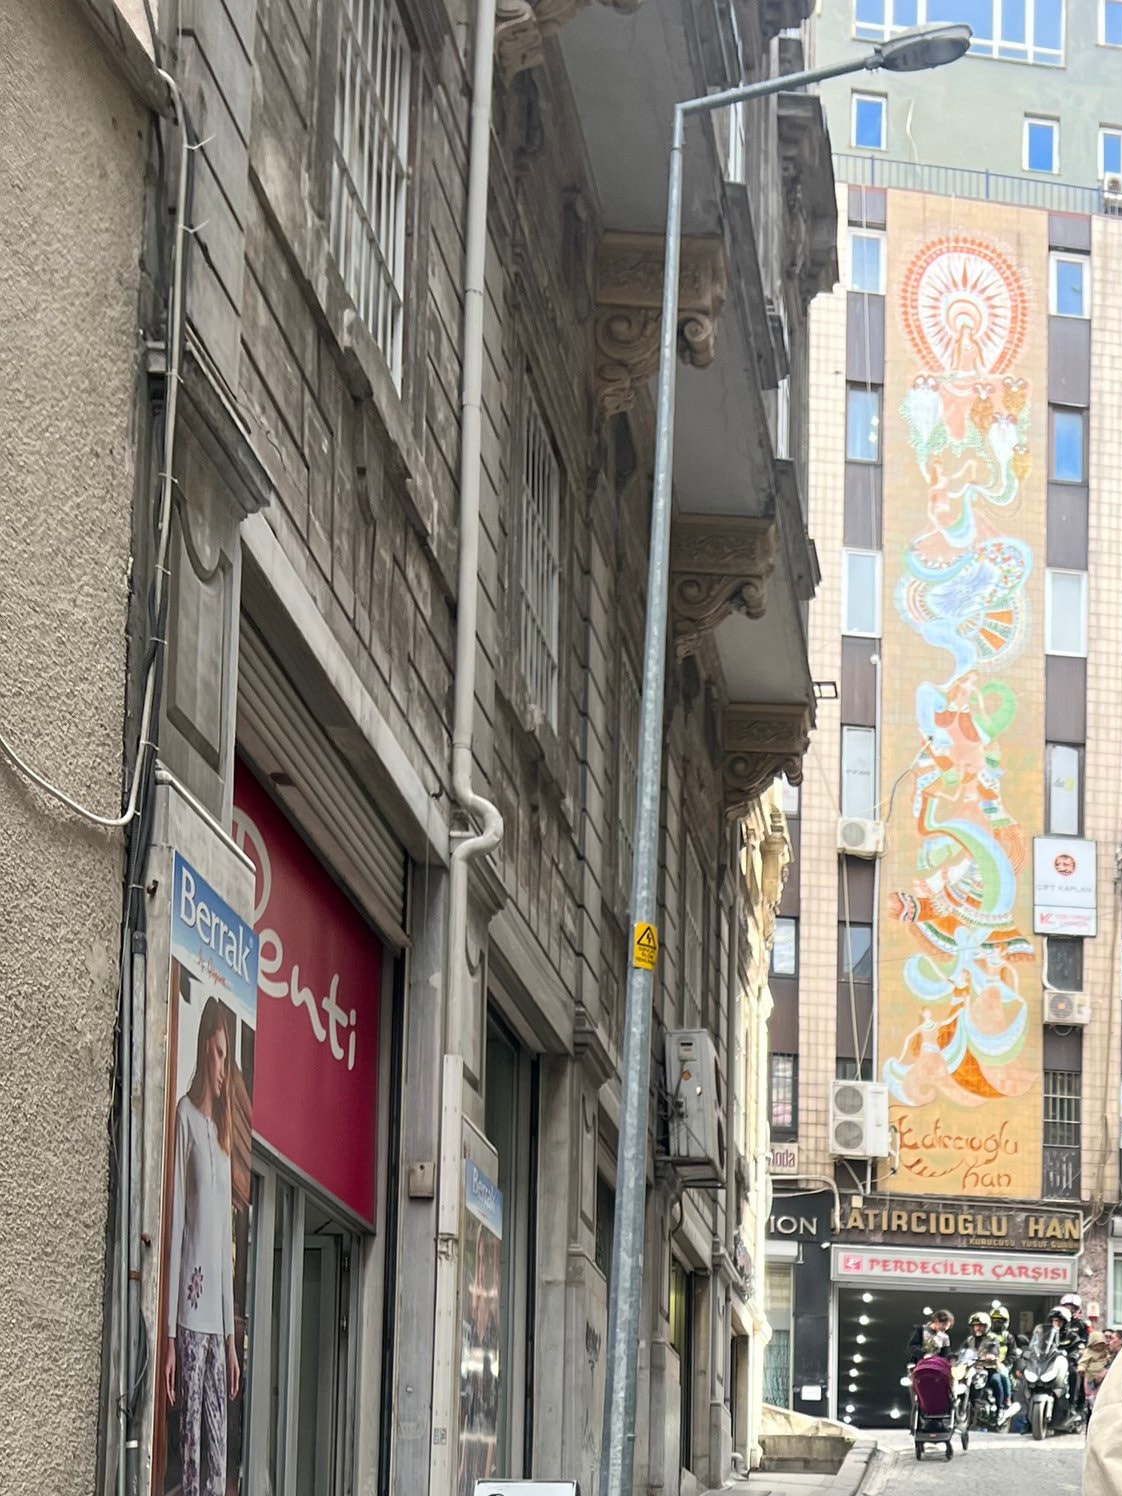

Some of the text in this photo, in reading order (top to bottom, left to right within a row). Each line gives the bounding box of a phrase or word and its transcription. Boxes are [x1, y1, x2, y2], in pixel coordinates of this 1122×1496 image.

[180, 865, 251, 983] Berrak
[1028, 1216, 1080, 1240] HAN
[1021, 1240, 1048, 1248] YUSUF
[867, 1258, 1068, 1281] PERDECİLER ÇARŞISI
